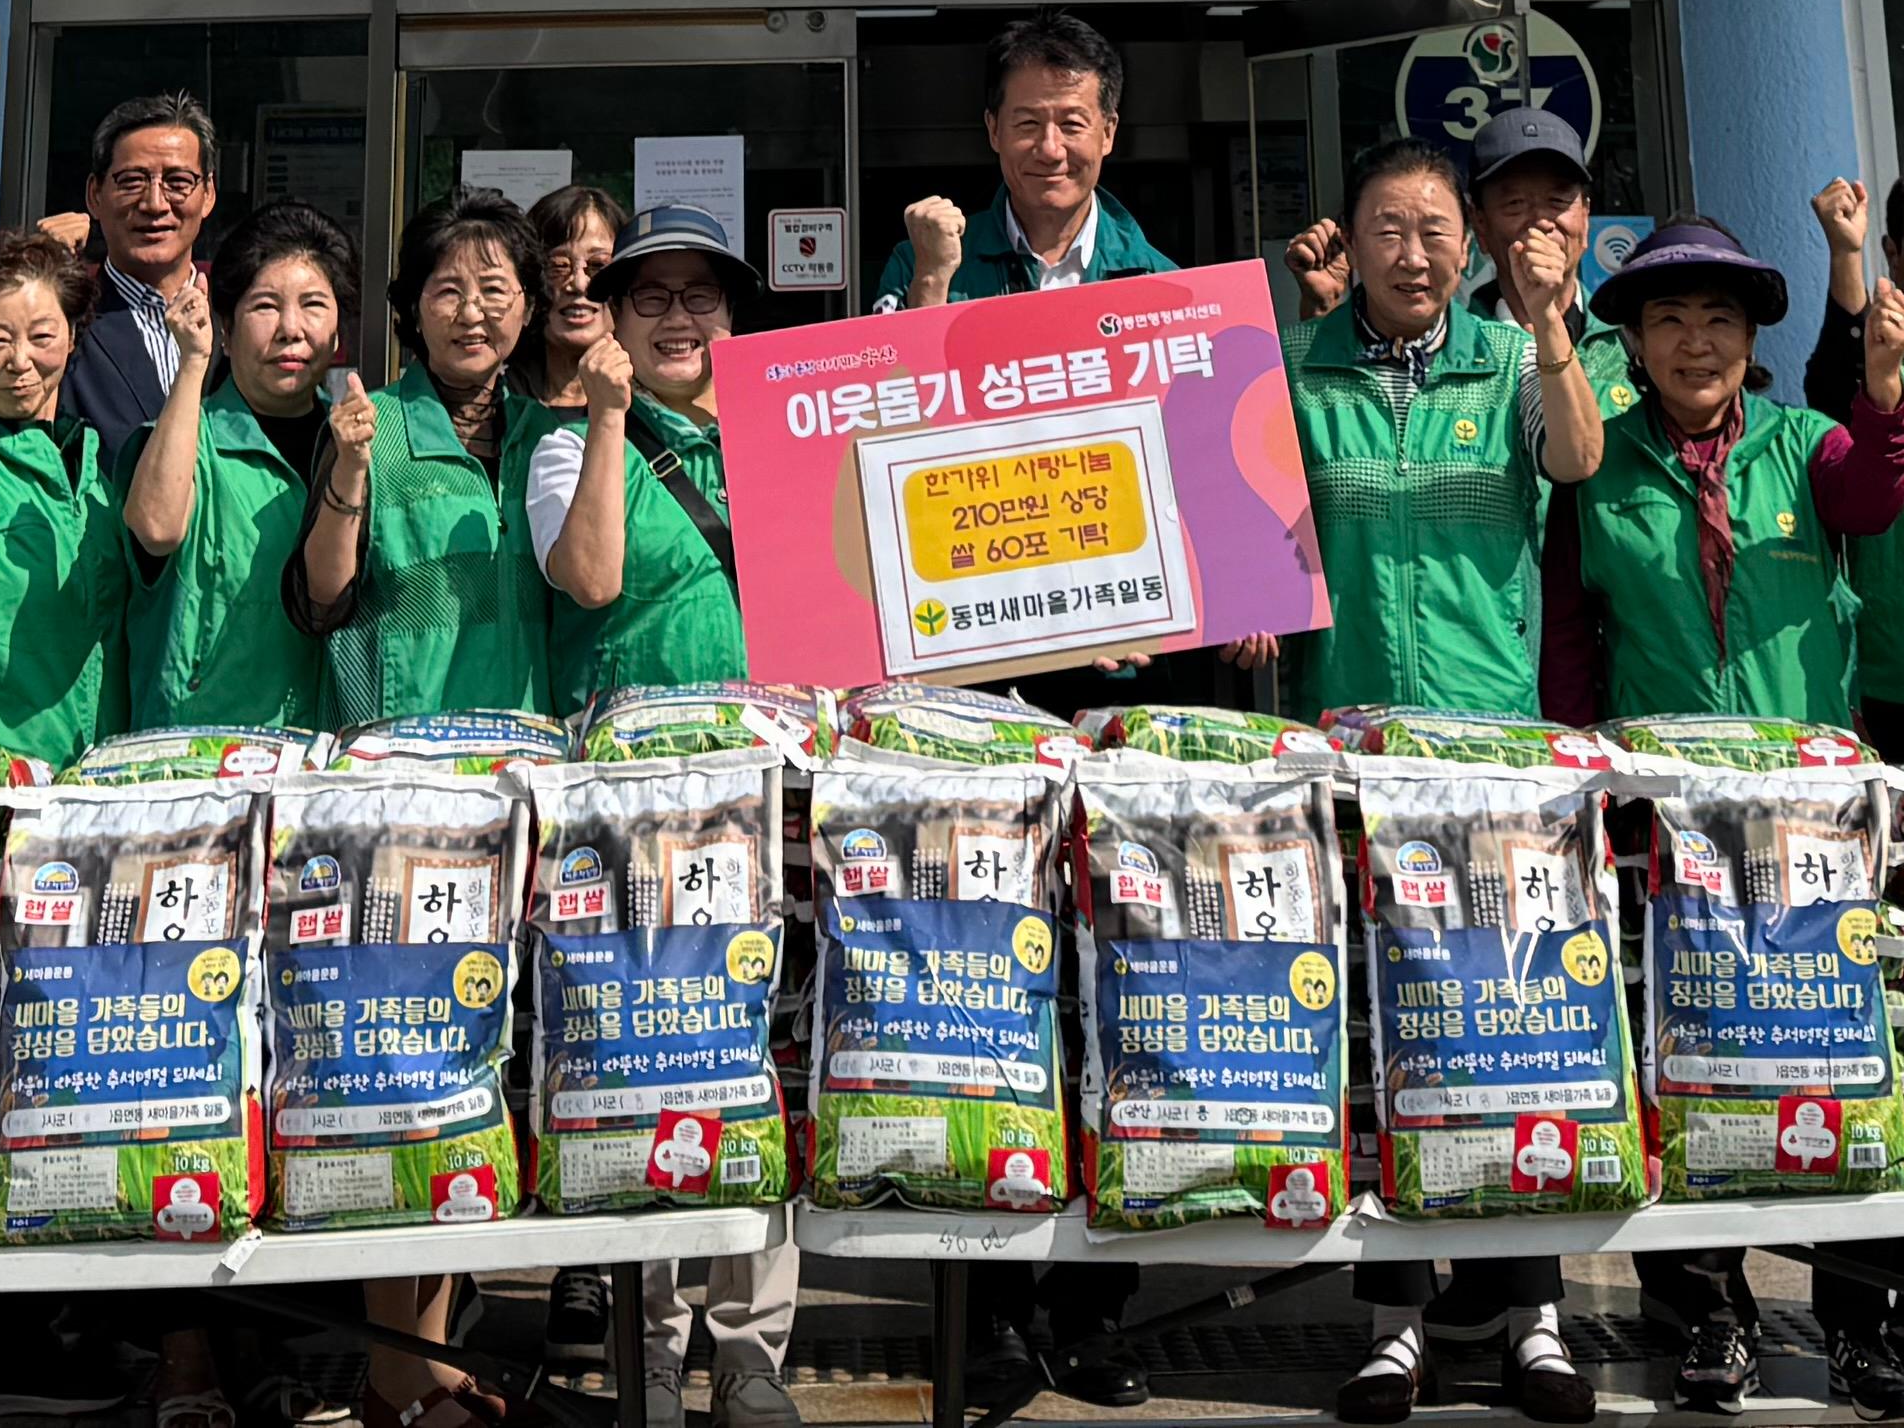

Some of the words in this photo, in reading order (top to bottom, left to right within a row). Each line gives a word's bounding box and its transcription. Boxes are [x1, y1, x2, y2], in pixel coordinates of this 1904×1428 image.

[782, 264, 806, 273] CCTV
[786, 369, 966, 439] 이웃돕기
[977, 347, 1113, 410] 성금품
[1123, 332, 1215, 388] 기탁
[924, 465, 999, 497] 한가위
[1013, 450, 1112, 483] 사랑나눔
[952, 494, 1050, 531] 210만원
[1060, 485, 1109, 515] 상당
[951, 542, 975, 569] 쌀
[987, 531, 1050, 563] 60포
[1059, 522, 1109, 550] 기탁
[951, 575, 1164, 631] 동면새마을가족일동
[841, 946, 911, 977] 새마을
[1670, 950, 1736, 978] 새마을
[1747, 952, 1840, 980] 가족들의
[561, 980, 623, 1011] 새마을
[632, 975, 726, 1004] 가족들의
[846, 975, 907, 1004] 정성을
[1397, 979, 1464, 1007] 새마을
[1669, 981, 1736, 1009] 정성을
[14, 998, 79, 1028] 새마을
[89, 993, 186, 1022] 가족들의
[287, 999, 346, 1029] 새마을
[356, 997, 451, 1025] 가족들의
[632, 1003, 752, 1038] 담았습니다.
[1118, 994, 1188, 1022] 새마을
[1197, 994, 1290, 1022] 가족들의
[1397, 1010, 1464, 1040] 정성을
[1475, 1006, 1598, 1036] 담았습니다.
[13, 1028, 76, 1061] 정성을
[87, 1021, 216, 1055] 담았습니다.
[354, 1026, 471, 1057] 담았습니다.
[1118, 1025, 1188, 1053] 정성을
[1198, 1025, 1320, 1055] 담았습니다.
[723, 1140, 736, 1153] 10
[740, 1139, 757, 1155] kg
[1002, 1129, 1014, 1144] 10
[1018, 1129, 1035, 1147] kg
[1583, 1137, 1596, 1153] 10
[1600, 1138, 1615, 1153] kg
[1850, 1125, 1864, 1139] 10
[175, 1156, 188, 1171] 10
[193, 1156, 210, 1172] kg
[448, 1154, 462, 1168] 10
[466, 1151, 484, 1167] kg
